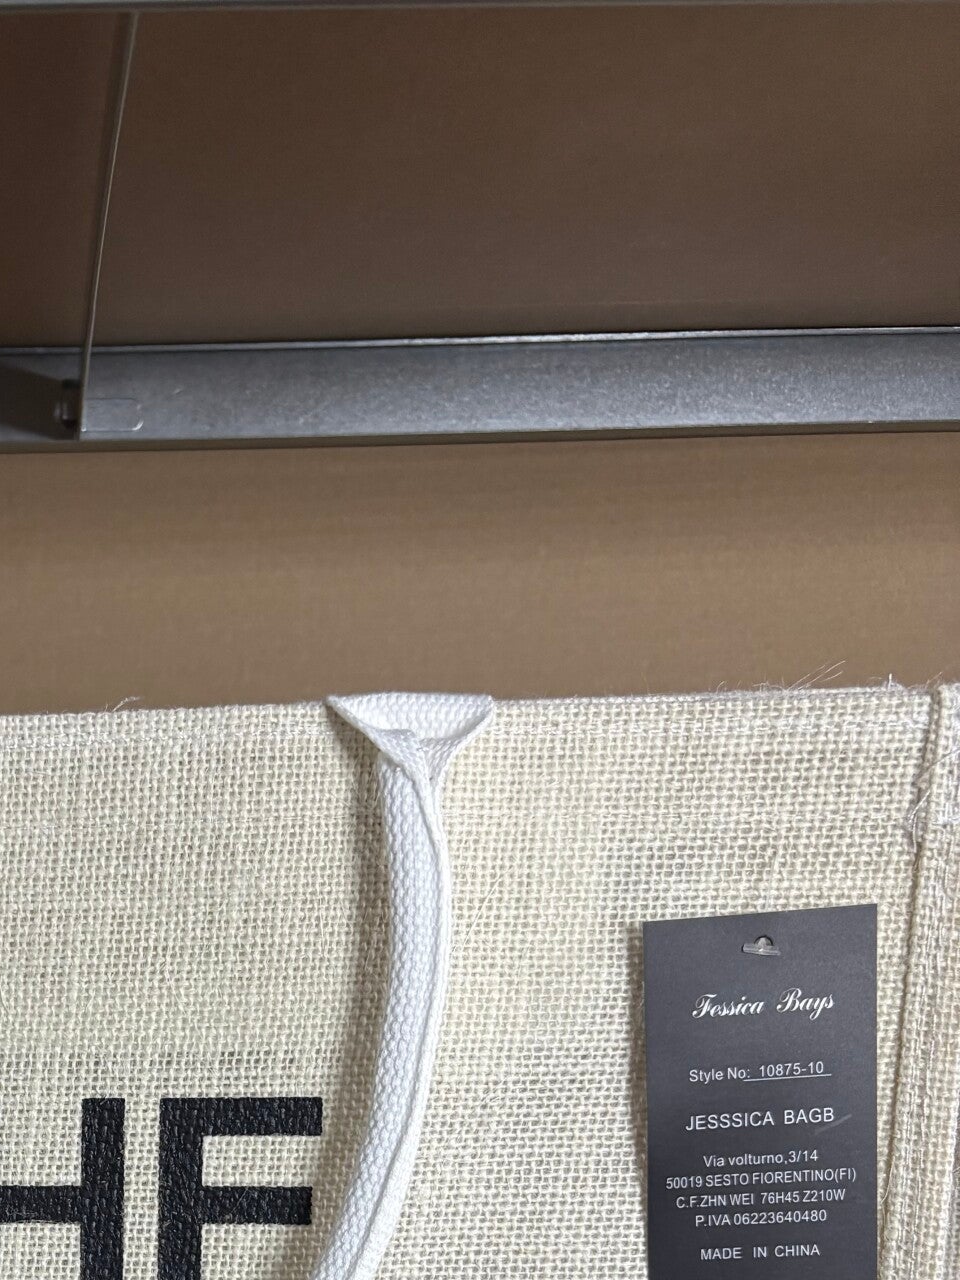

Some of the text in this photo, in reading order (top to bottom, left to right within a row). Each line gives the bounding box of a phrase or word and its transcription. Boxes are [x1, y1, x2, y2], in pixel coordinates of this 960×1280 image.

[689, 1061, 824, 1084] Style No: 10875-10
[685, 1107, 835, 1131] JESSSICA BAGB
[703, 1155, 725, 1167] Via
[666, 1168, 857, 1189] 50019 SESTO FIORENTINO(FI)
[676, 1197, 727, 1209] C.F.ZHN
[729, 1194, 754, 1205] WEI
[695, 1210, 827, 1227] P.IVA 06223640480
[700, 1244, 820, 1260] MADE IN CHINA
